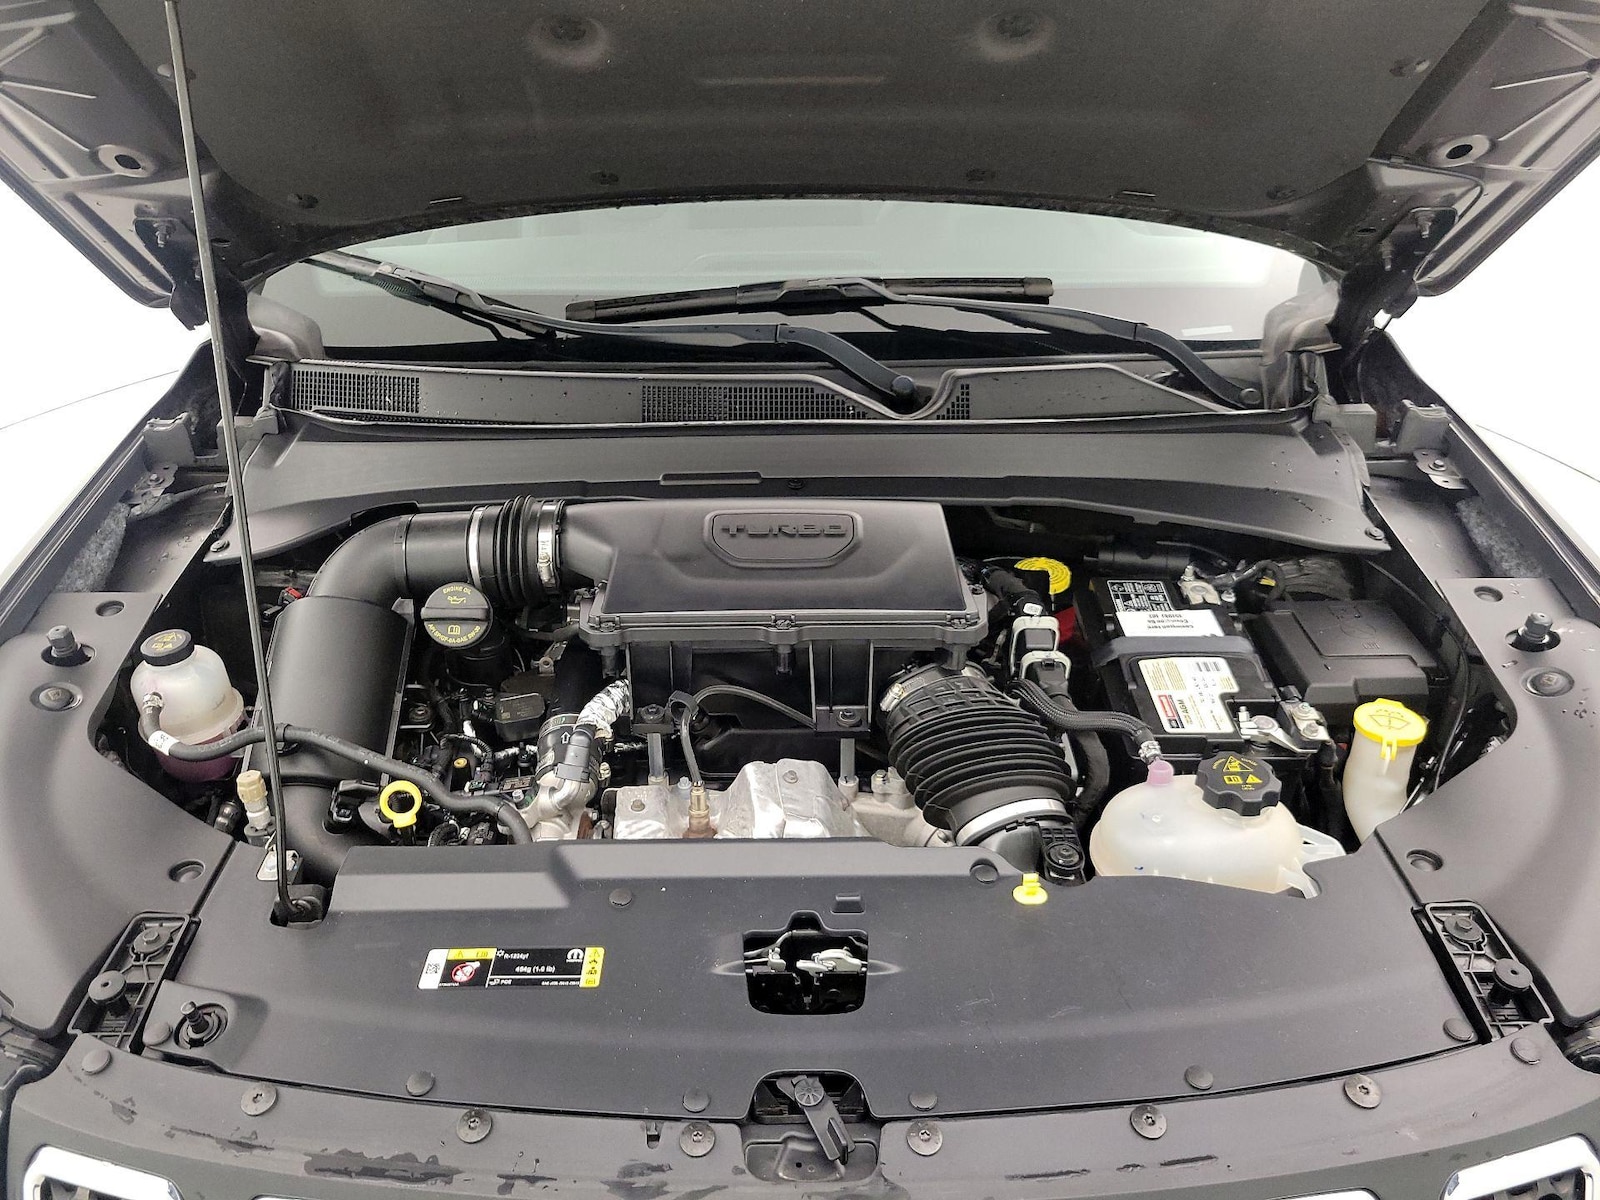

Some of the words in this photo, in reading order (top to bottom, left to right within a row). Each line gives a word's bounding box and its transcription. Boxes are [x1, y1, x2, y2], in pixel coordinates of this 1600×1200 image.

[721, 524, 848, 537] TURBO
[443, 586, 463, 594] ENGINE
[463, 587, 472, 595] OIL
[1177, 699, 1190, 714] AGM
[504, 953, 530, 961] R-1234yf
